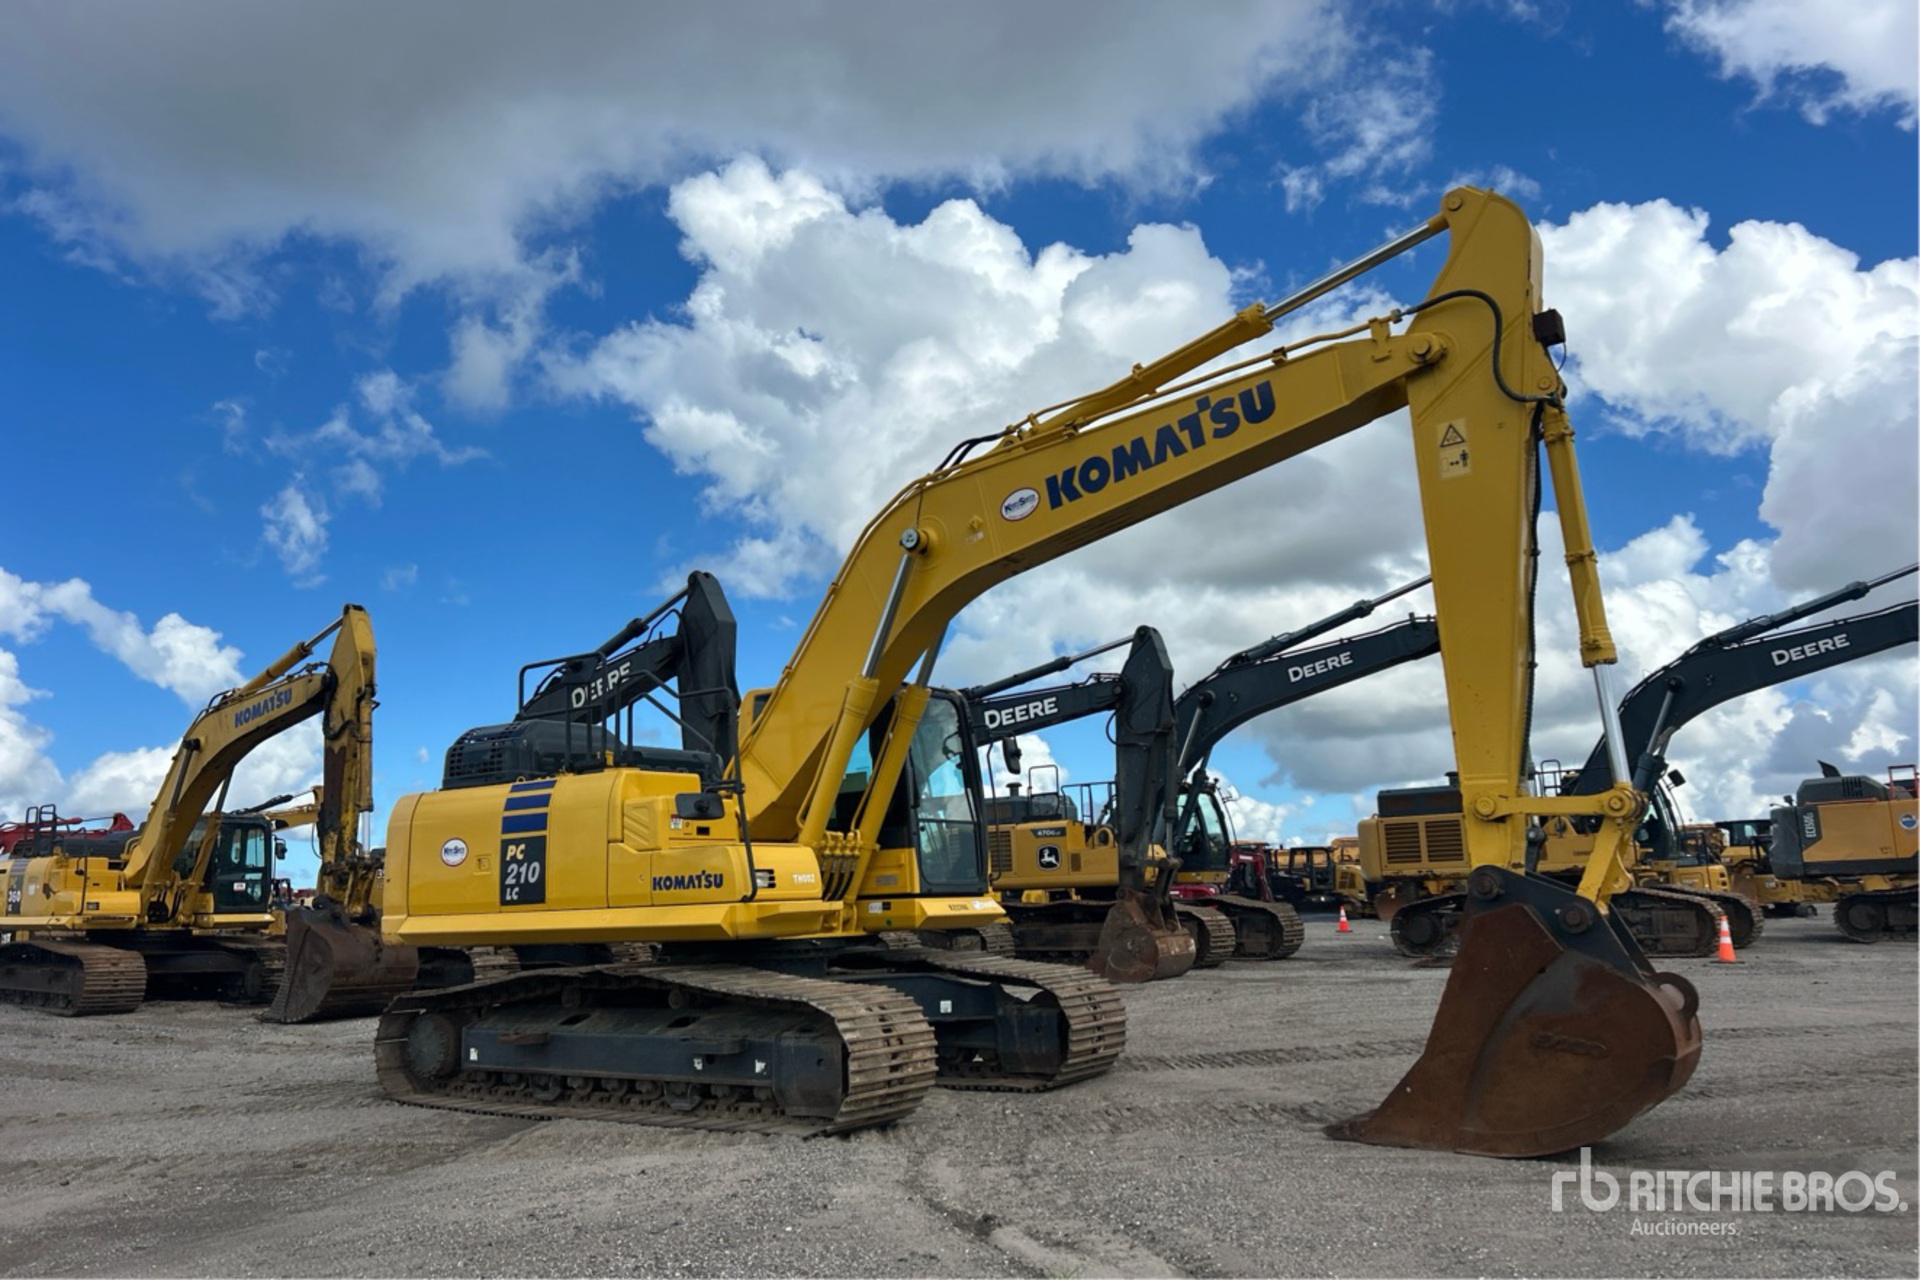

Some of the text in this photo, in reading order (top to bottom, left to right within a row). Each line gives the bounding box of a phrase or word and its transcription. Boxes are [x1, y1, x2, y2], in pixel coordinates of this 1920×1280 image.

[1045, 380, 1276, 510] KOMATSU
[1771, 633, 1850, 666] DEERE
[1288, 651, 1354, 683] DEERE
[235, 688, 293, 728] KOMATSU
[983, 697, 1059, 729] DEERE
[506, 843, 526, 861] PC
[504, 861, 540, 885] 210
[652, 870, 723, 891] KOMATSU
[506, 887, 519, 901] LC
